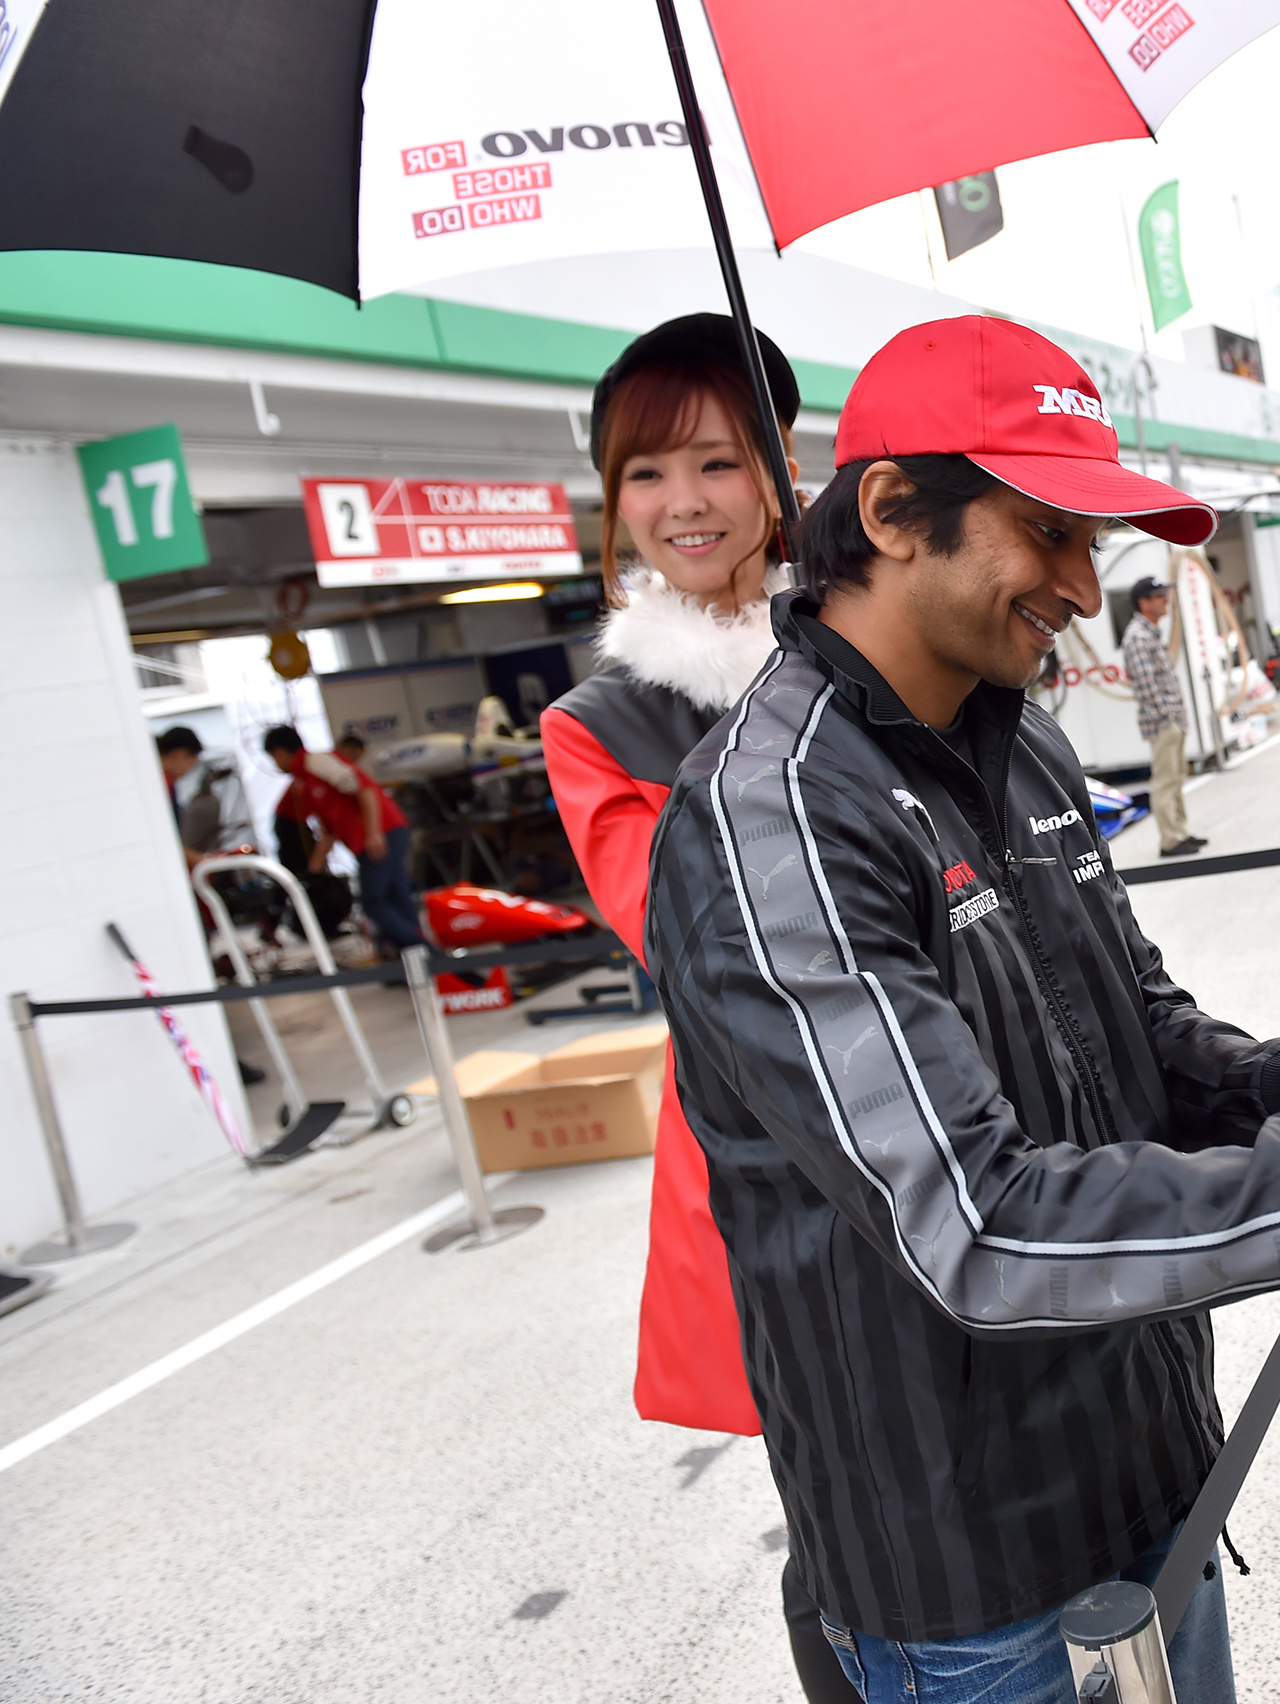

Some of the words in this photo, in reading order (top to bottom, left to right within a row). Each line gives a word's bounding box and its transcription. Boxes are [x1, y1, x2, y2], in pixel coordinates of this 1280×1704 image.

[96, 457, 178, 547] 17
[476, 486, 552, 515] RACING
[338, 500, 360, 541] 2
[446, 525, 569, 551] S.KIYOHARA
[739, 816, 792, 847] PUMA
[763, 911, 819, 943] PUMA
[847, 1082, 905, 1120] PUMA
